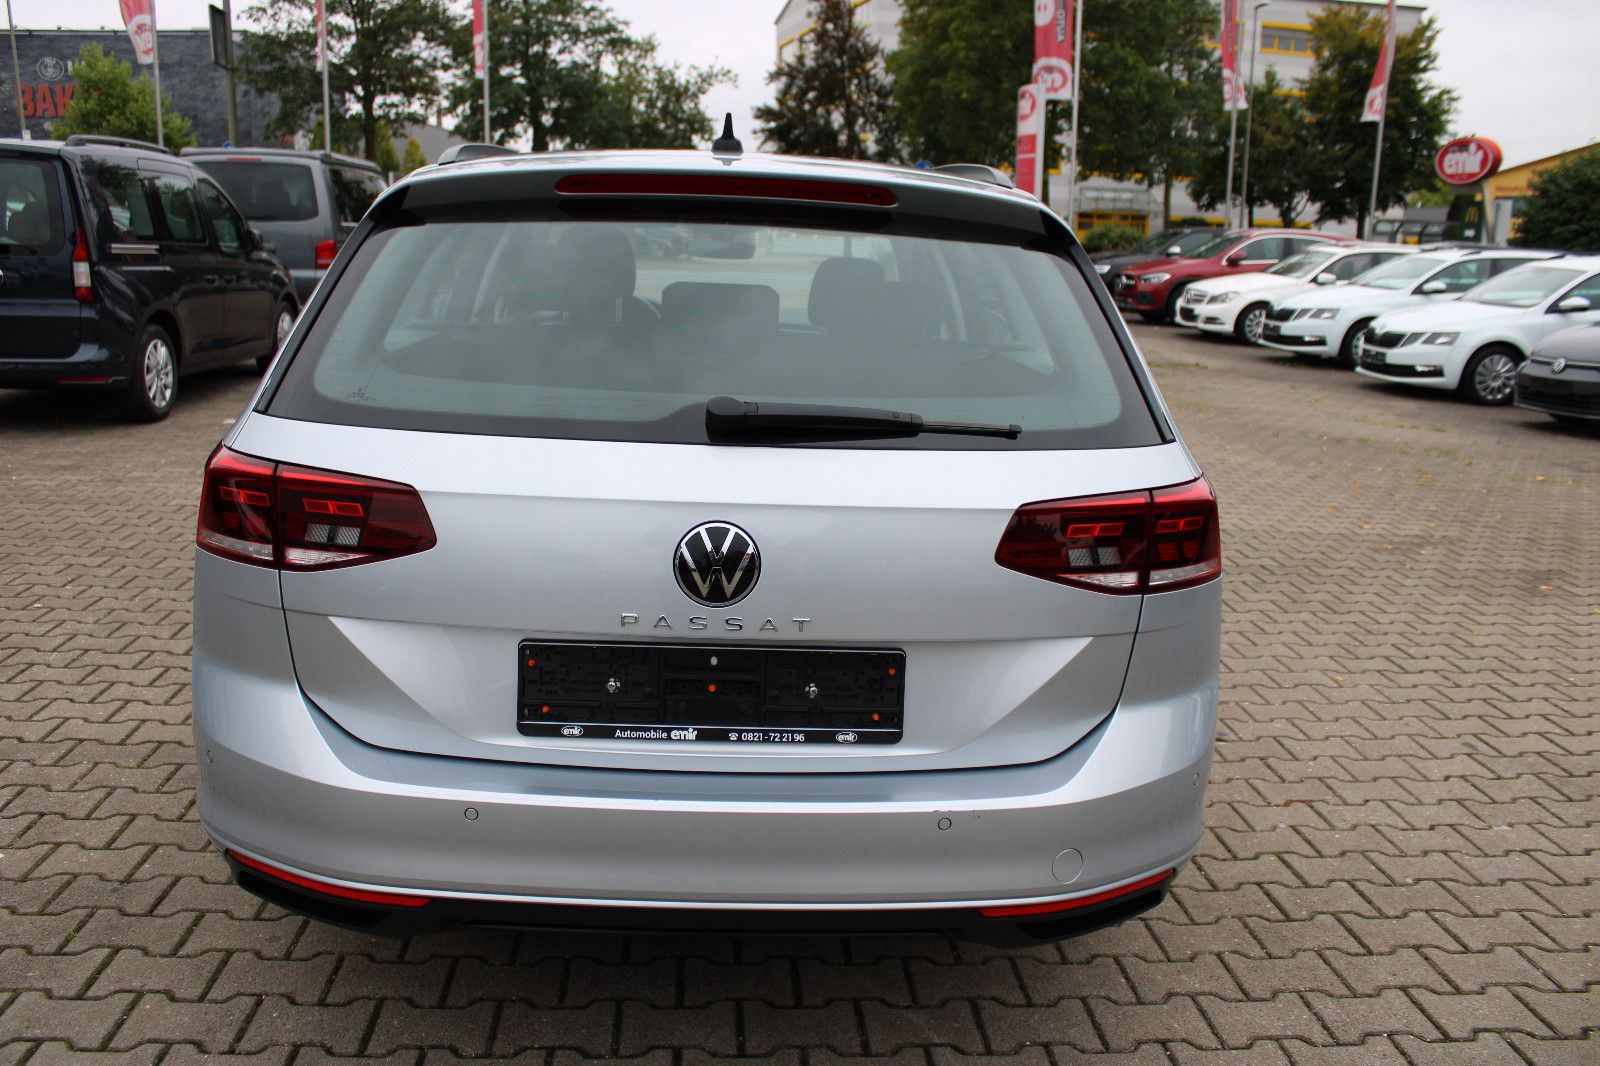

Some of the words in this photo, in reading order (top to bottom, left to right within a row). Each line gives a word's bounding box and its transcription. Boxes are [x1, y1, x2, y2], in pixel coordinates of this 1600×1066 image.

[14, 83, 80, 117] BAK
[1442, 142, 1484, 174] emir
[620, 613, 812, 632] PASSAT
[562, 726, 582, 736] emir
[614, 729, 668, 739] Automobile
[670, 728, 698, 740] emir
[837, 732, 856, 742] emir
